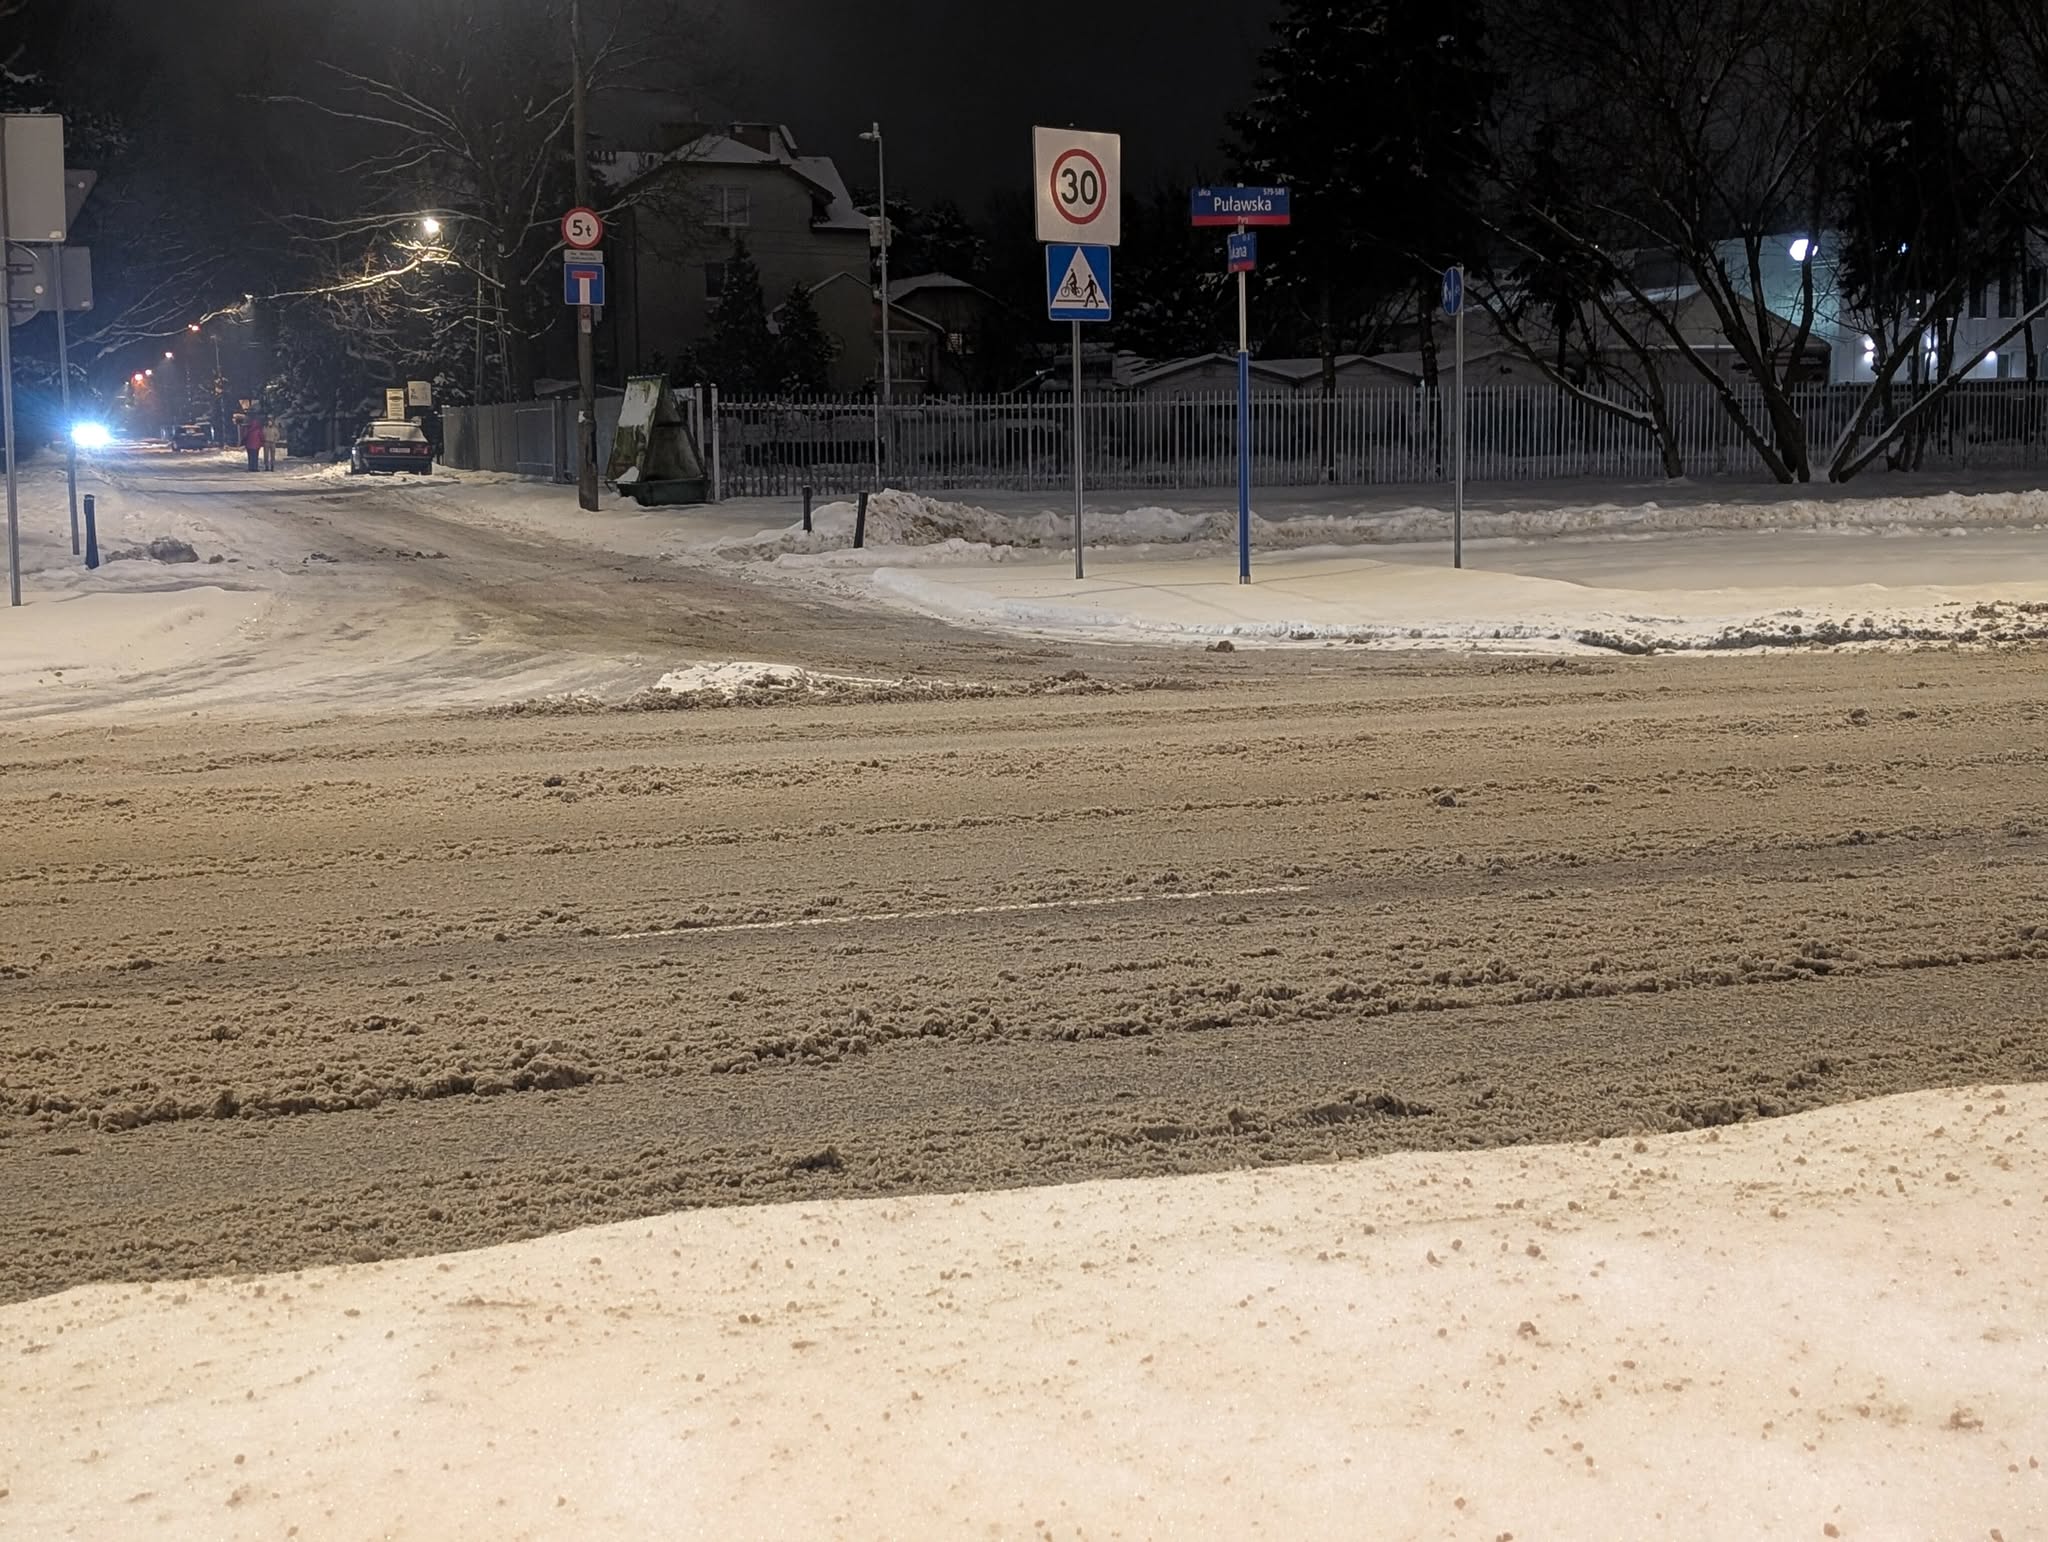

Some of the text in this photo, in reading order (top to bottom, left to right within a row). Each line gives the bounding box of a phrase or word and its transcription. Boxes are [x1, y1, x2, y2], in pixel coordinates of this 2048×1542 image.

[1061, 168, 1098, 205] 30
[1214, 196, 1272, 212] Puławska
[572, 219, 592, 237] 5t
